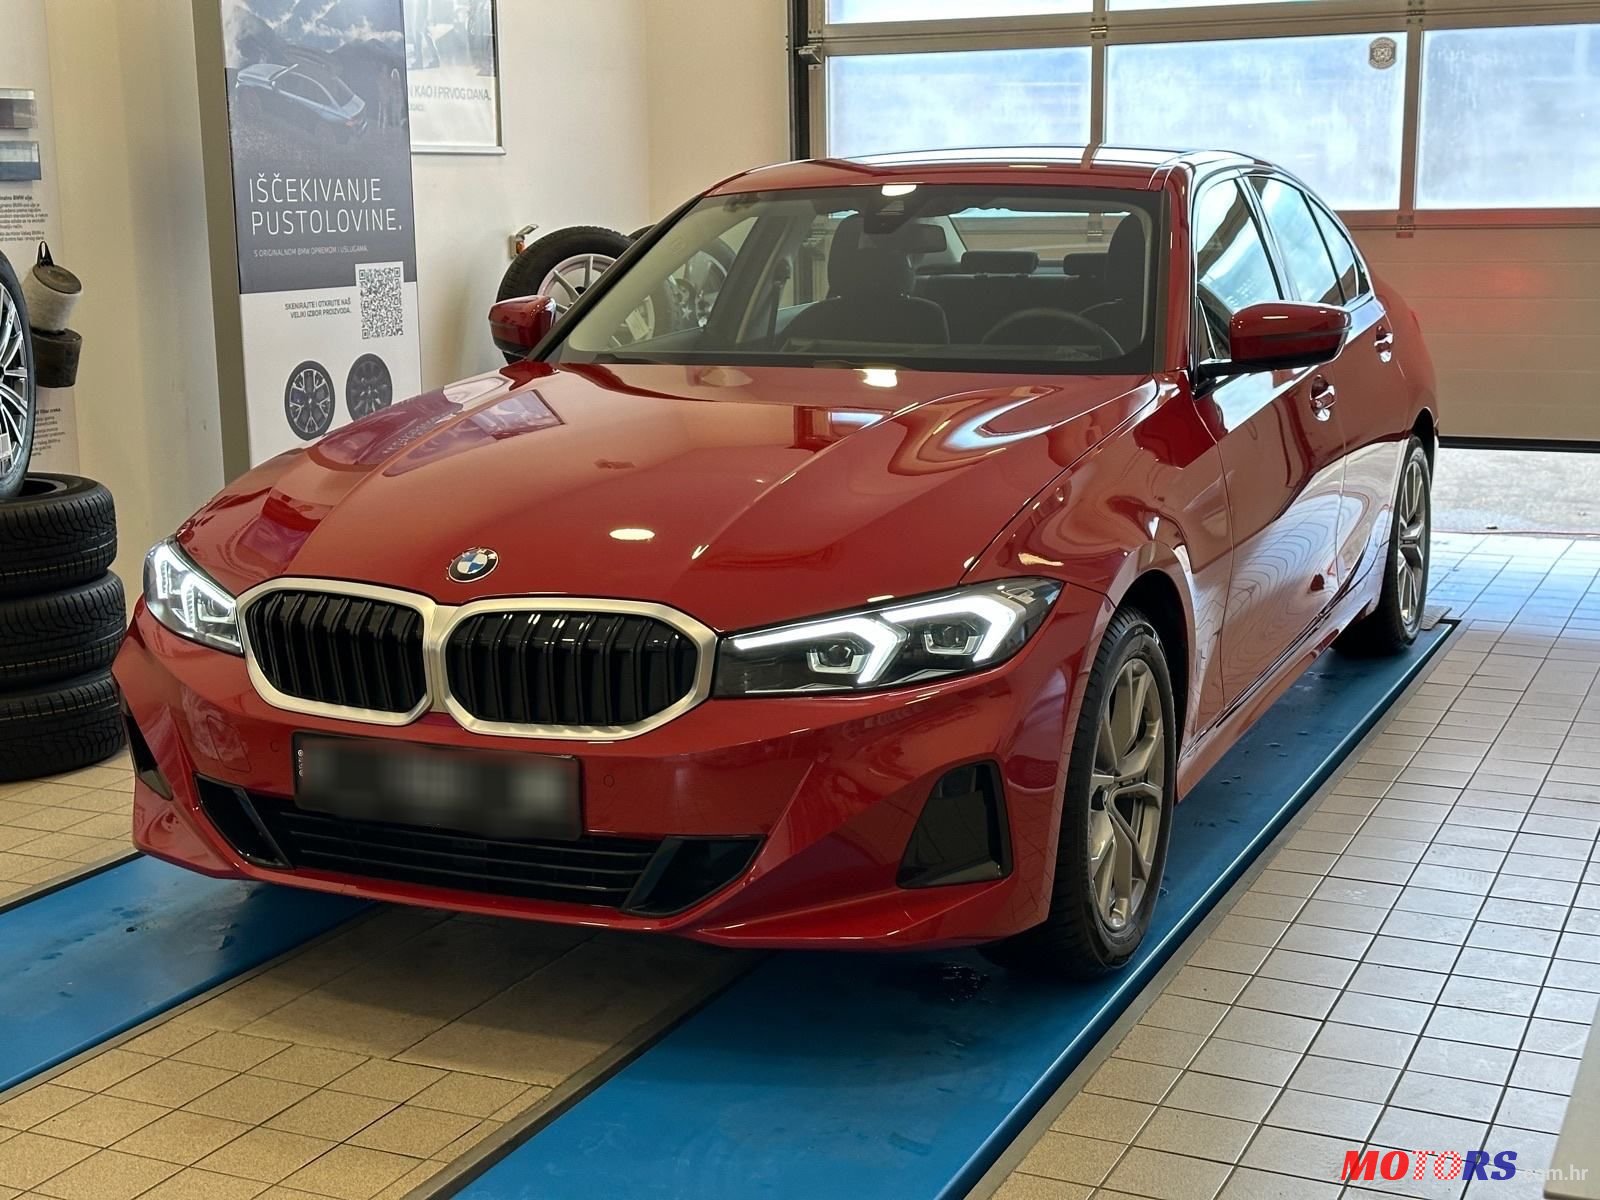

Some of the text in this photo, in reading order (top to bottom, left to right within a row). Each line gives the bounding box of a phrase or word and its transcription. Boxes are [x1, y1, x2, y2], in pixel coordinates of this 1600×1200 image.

[415, 85, 433, 98] KAO
[438, 86, 466, 101] PRVOG
[249, 172, 382, 203] IŠČEKIVANJE
[251, 208, 402, 236] PUSTOLOVINE.
[297, 247, 310, 256] BMW
[307, 309, 322, 318] IZBOR
